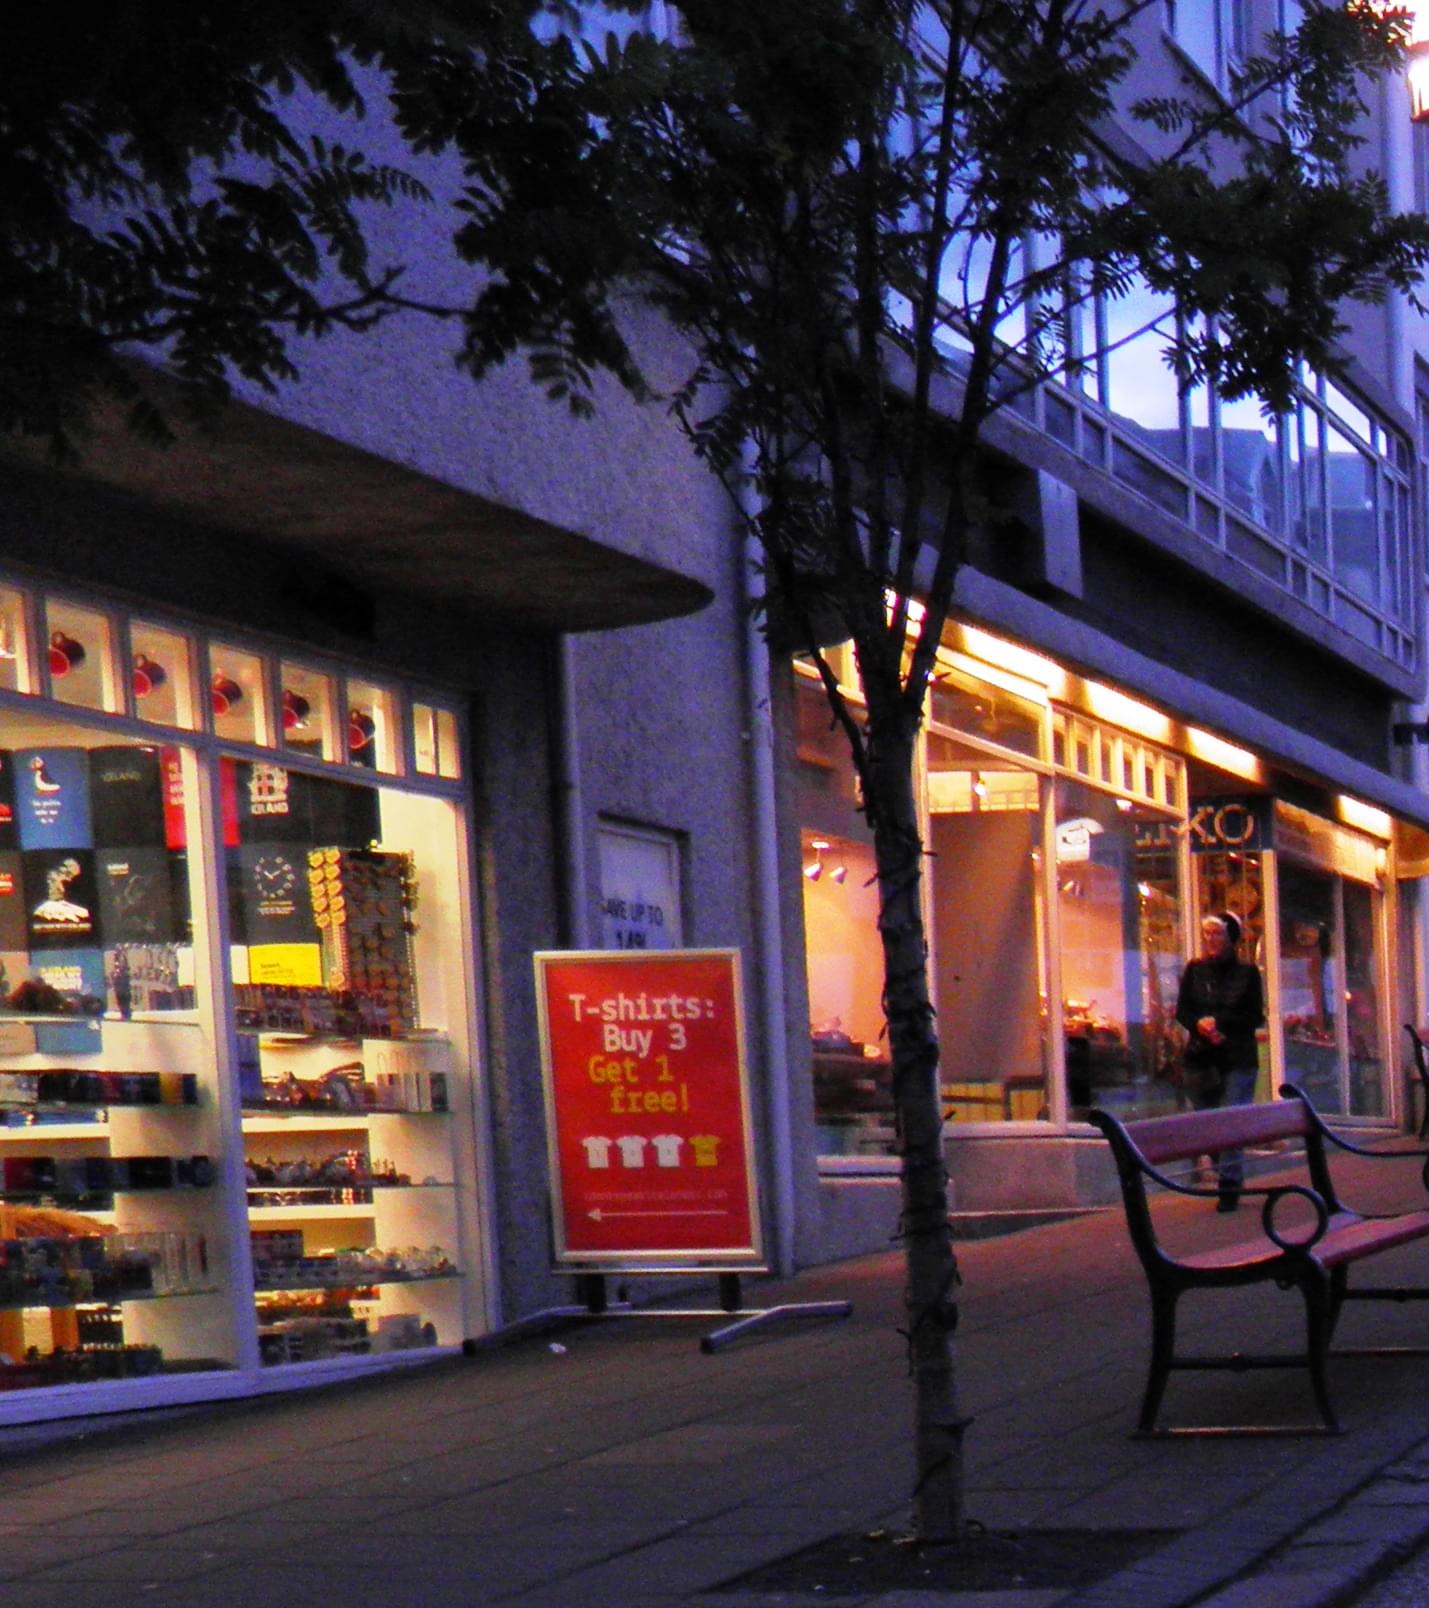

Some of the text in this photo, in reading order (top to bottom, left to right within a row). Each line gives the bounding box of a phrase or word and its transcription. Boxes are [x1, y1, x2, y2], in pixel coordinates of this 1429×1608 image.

[568, 991, 716, 1023] T-shirts:
[603, 1022, 687, 1058] Buy 3
[588, 1054, 674, 1083] Get 1
[609, 1083, 690, 1115] free!
